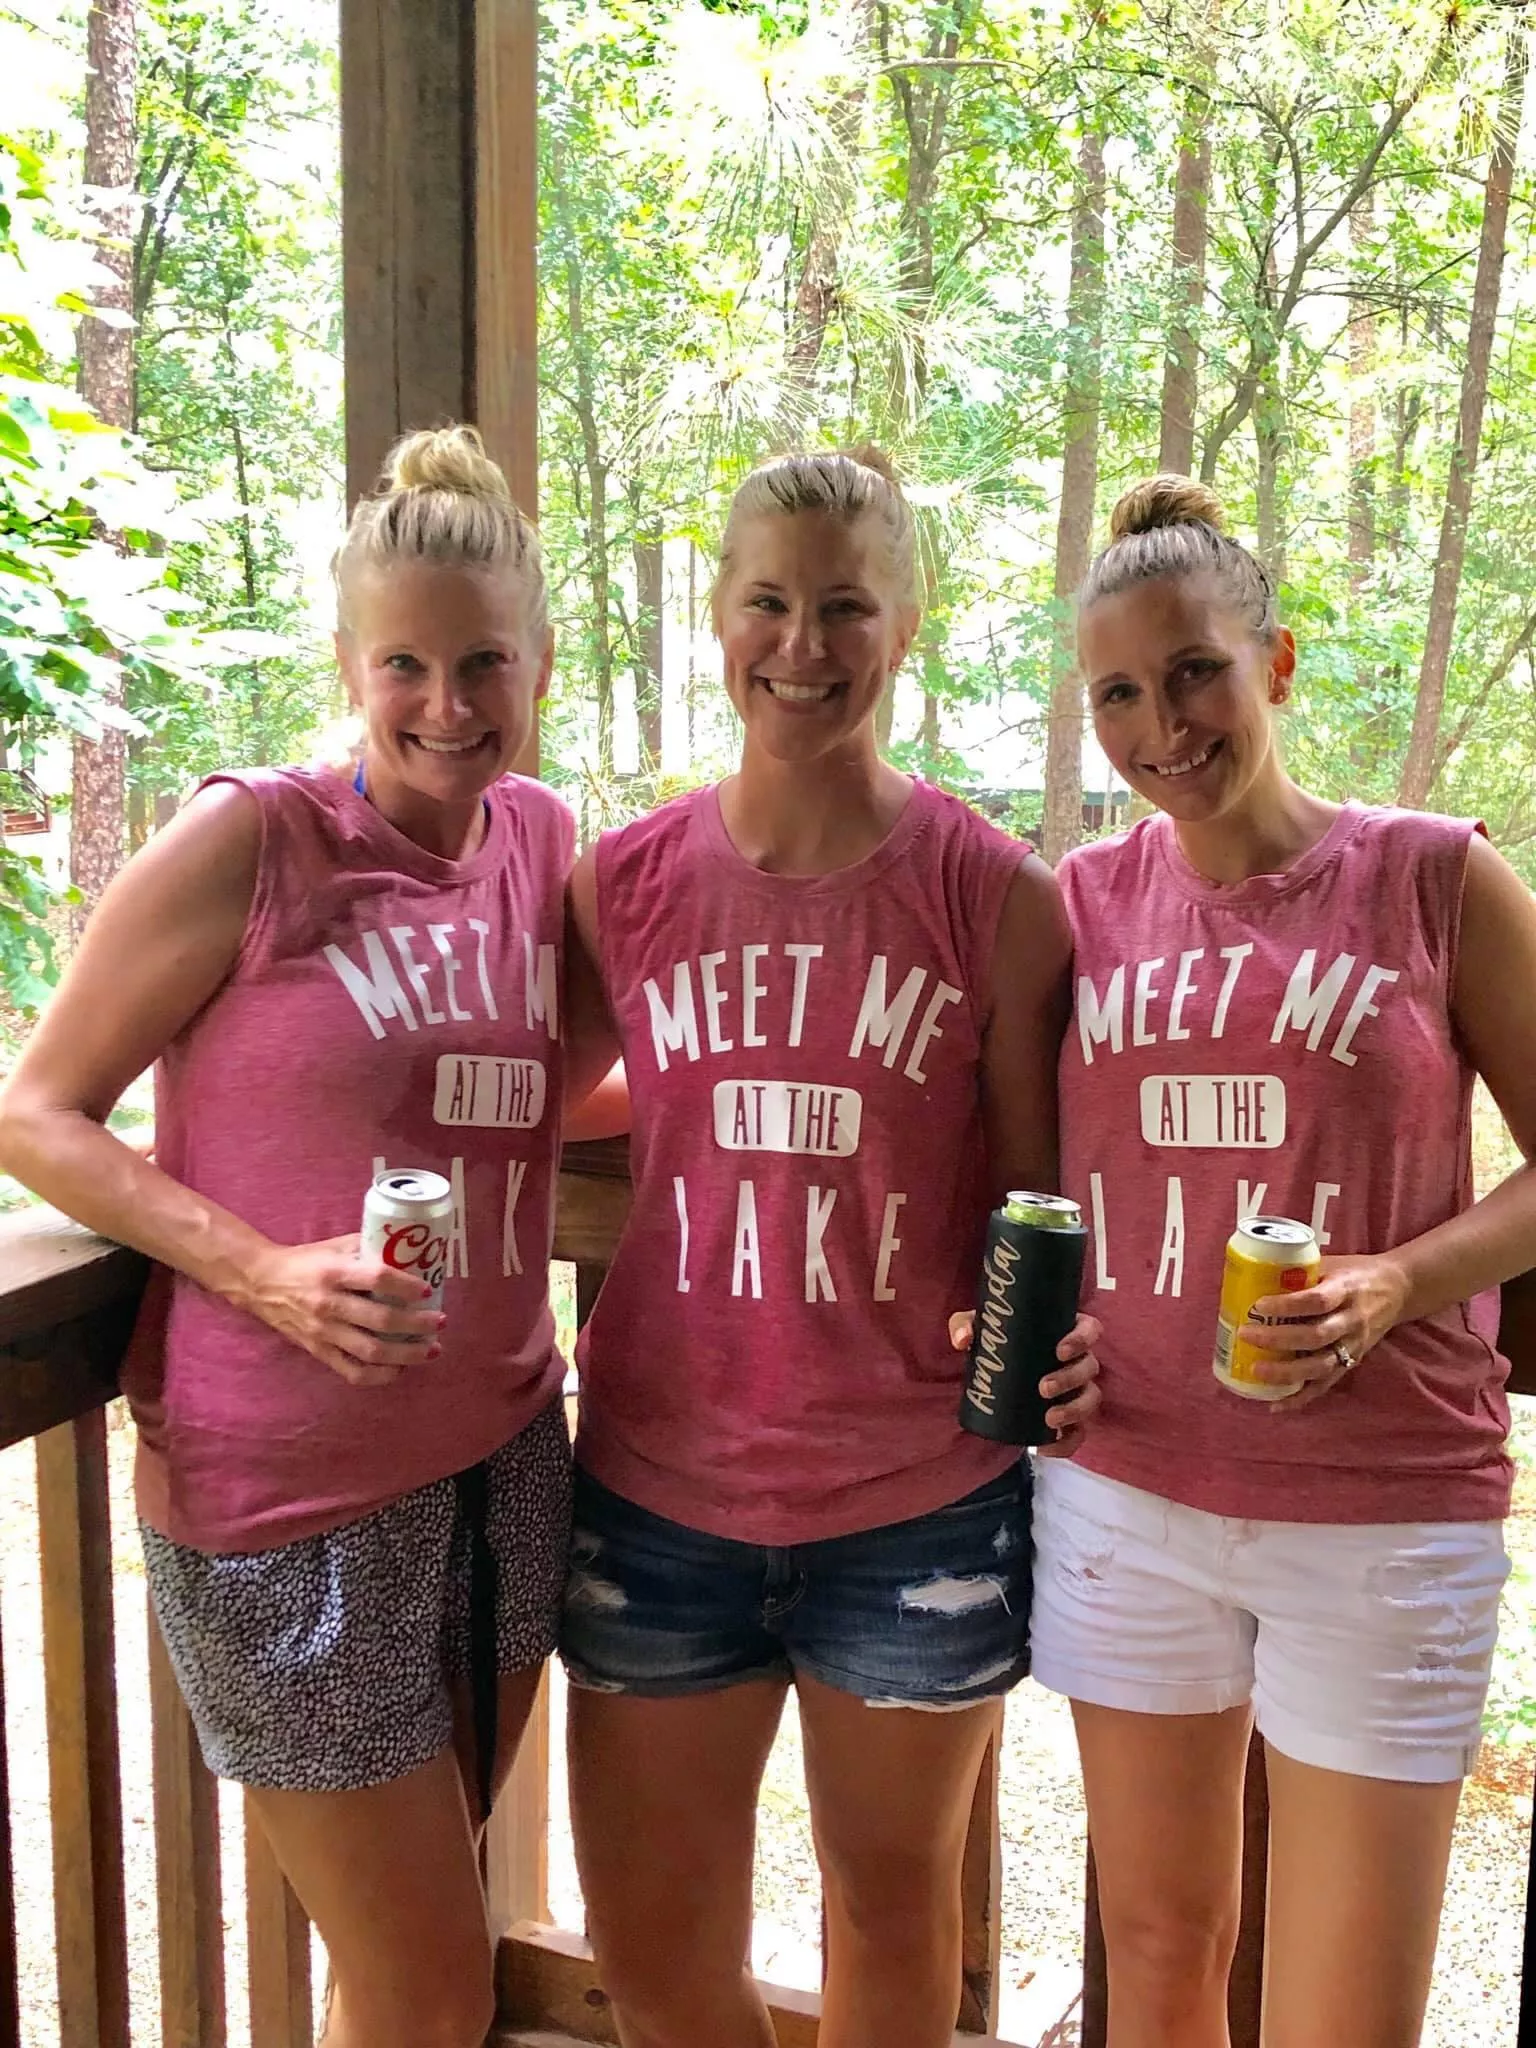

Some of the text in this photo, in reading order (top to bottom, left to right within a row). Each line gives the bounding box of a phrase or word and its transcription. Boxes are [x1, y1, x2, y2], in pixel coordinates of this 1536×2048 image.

[323, 918, 499, 1041] MEET
[643, 943, 963, 1085] MEET ME
[1078, 942, 1400, 1067] MEET ME
[448, 1060, 535, 1123] AT THE
[733, 1086, 843, 1151] AT THE
[1160, 1081, 1268, 1143] AT THE
[372, 1156, 527, 1279] AK
[673, 1176, 907, 1303] LAKE
[966, 1236, 1022, 1416] Amanda
